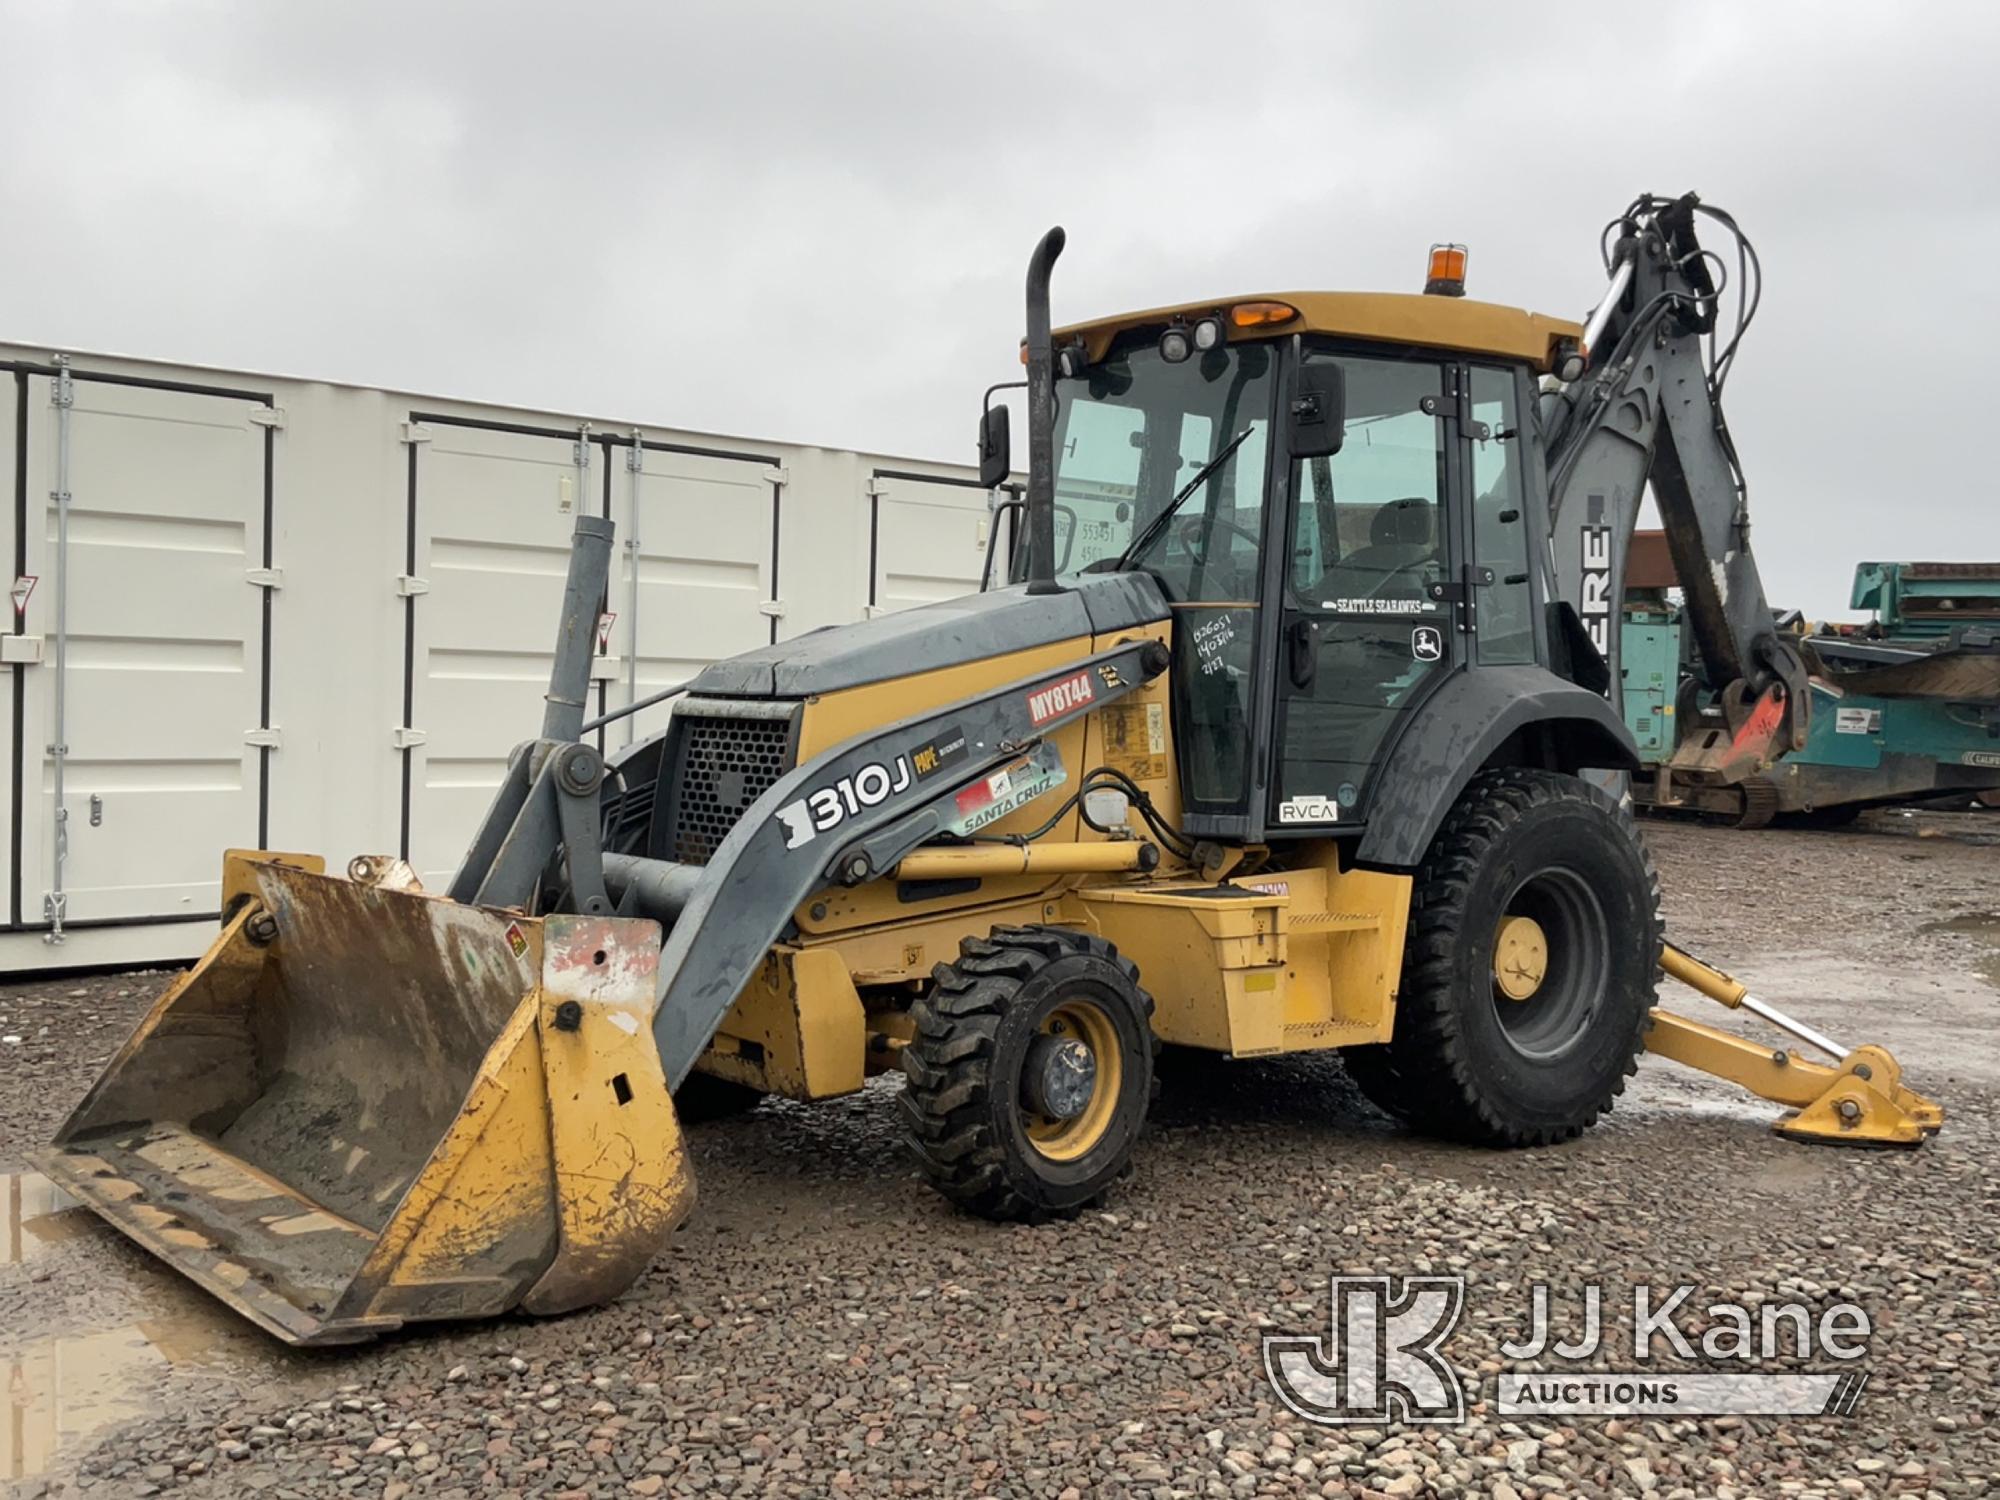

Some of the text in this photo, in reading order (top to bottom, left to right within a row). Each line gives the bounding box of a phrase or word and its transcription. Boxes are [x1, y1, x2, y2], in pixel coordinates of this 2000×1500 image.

[1337, 599, 1421, 614] SEATTLE SEAHAWKS
[1581, 529, 1610, 678] ERE
[1029, 674, 1092, 722] MY8T44
[808, 756, 911, 832] 310J
[964, 776, 1053, 834] SANTA CRUZ
[1282, 804, 1333, 819] RVCA
